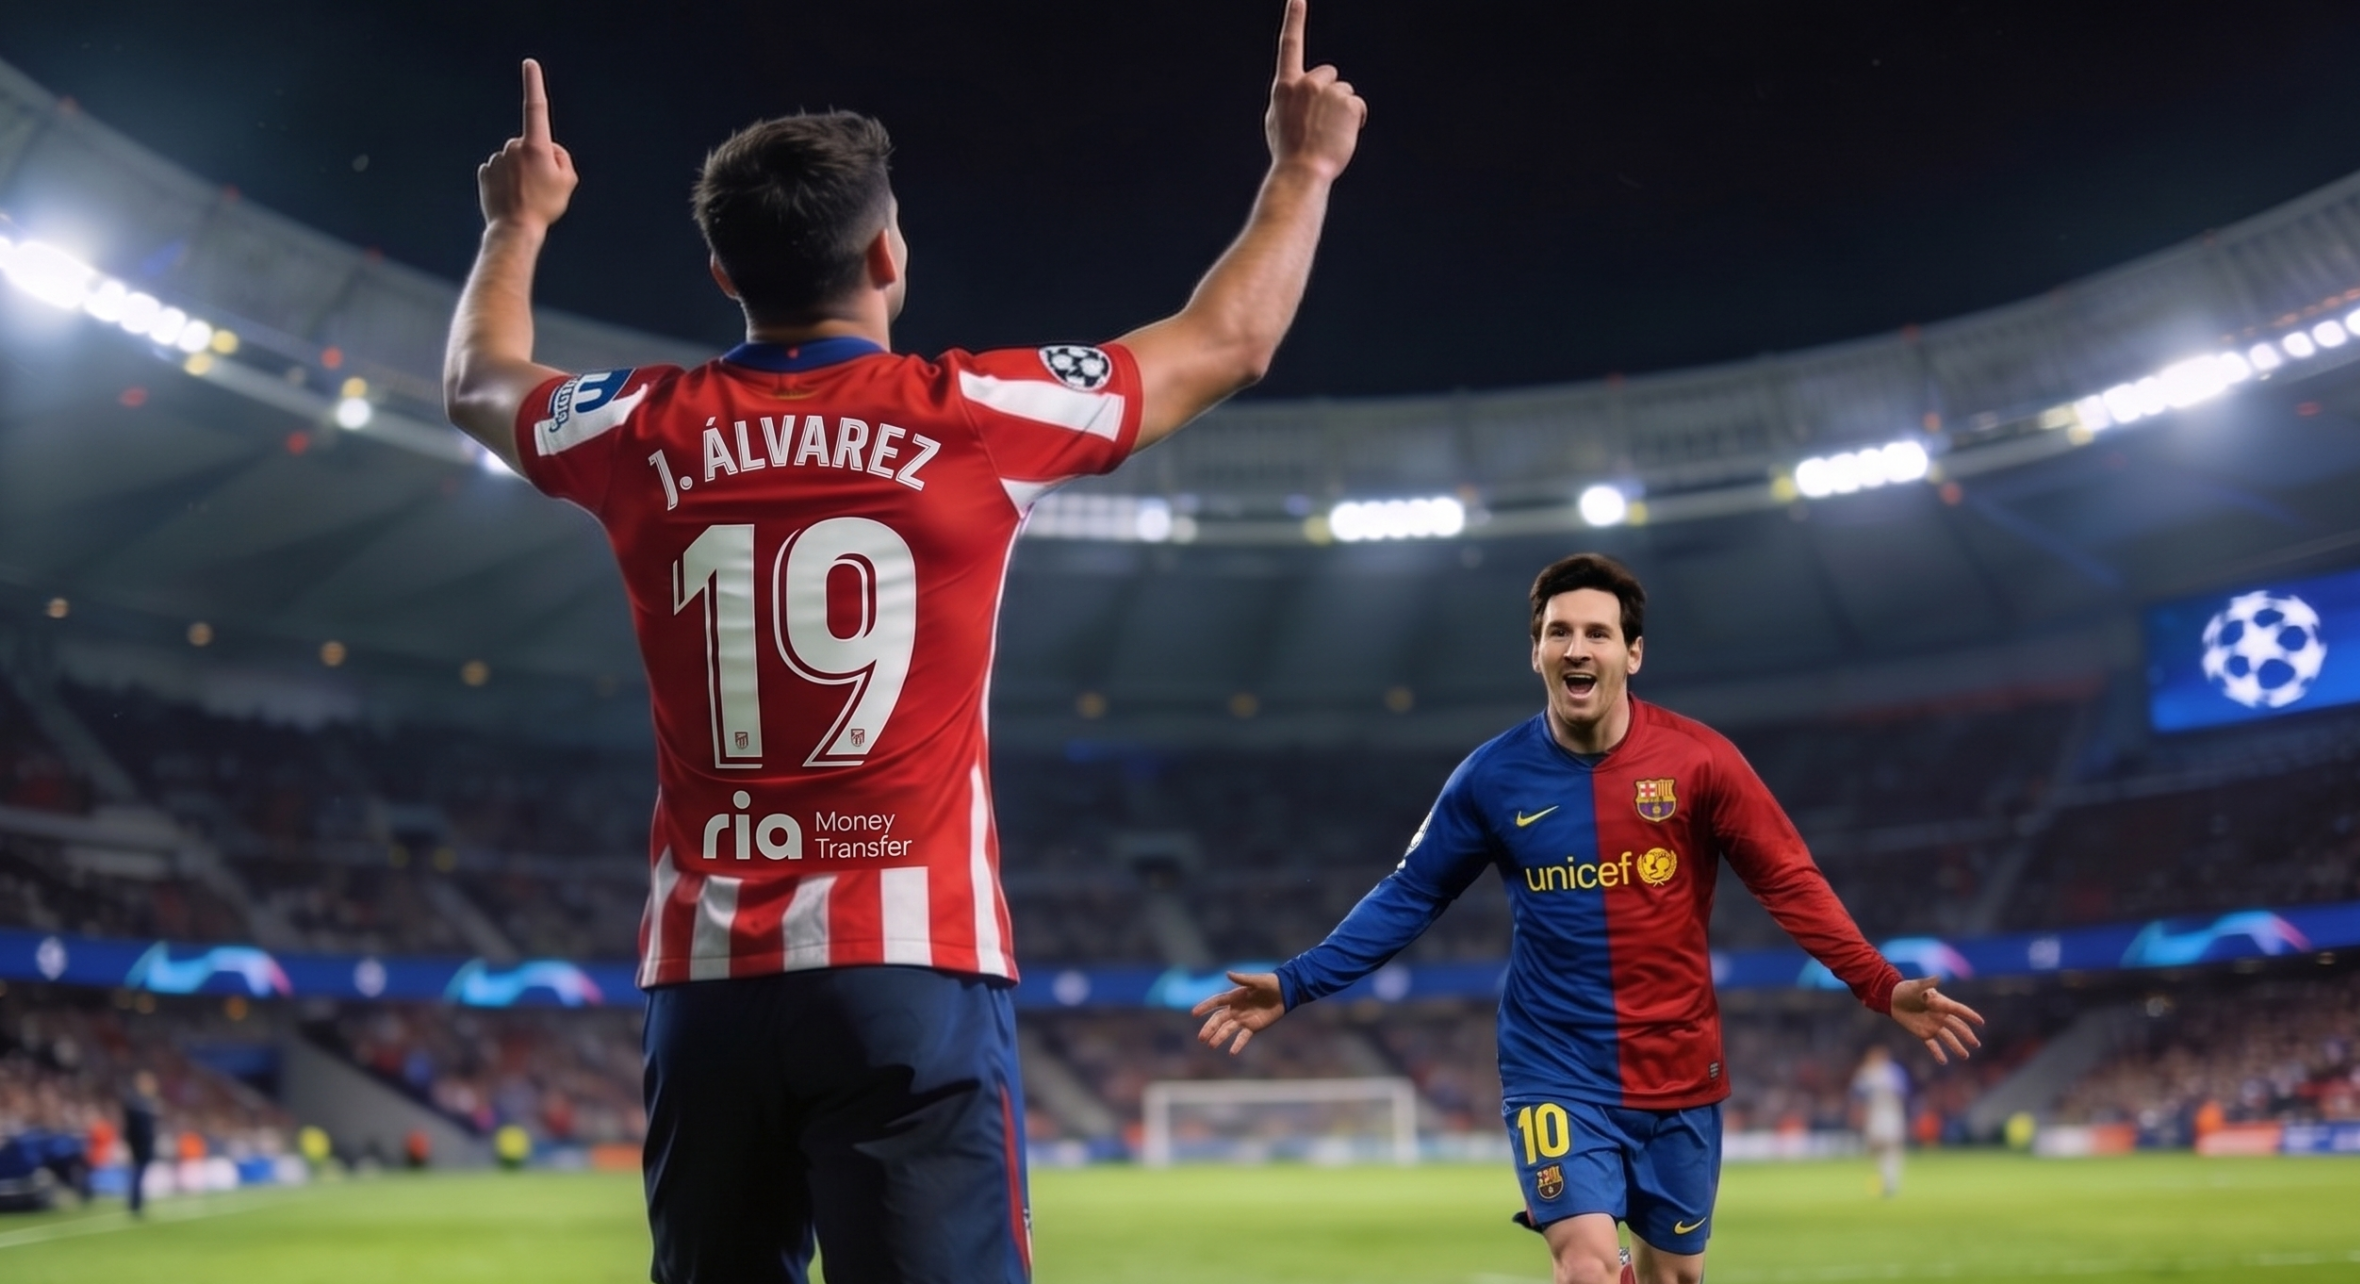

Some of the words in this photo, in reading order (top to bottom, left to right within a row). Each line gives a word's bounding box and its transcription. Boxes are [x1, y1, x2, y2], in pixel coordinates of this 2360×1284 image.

[648, 449, 693, 511] J.
[703, 415, 942, 491] ÁLVAREZ
[672, 516, 917, 769] 19
[702, 790, 803, 860] ria
[815, 811, 896, 832] Money
[815, 836, 912, 859] Transfer
[1525, 851, 1633, 892] unicef
[1517, 1102, 1571, 1165] 10
